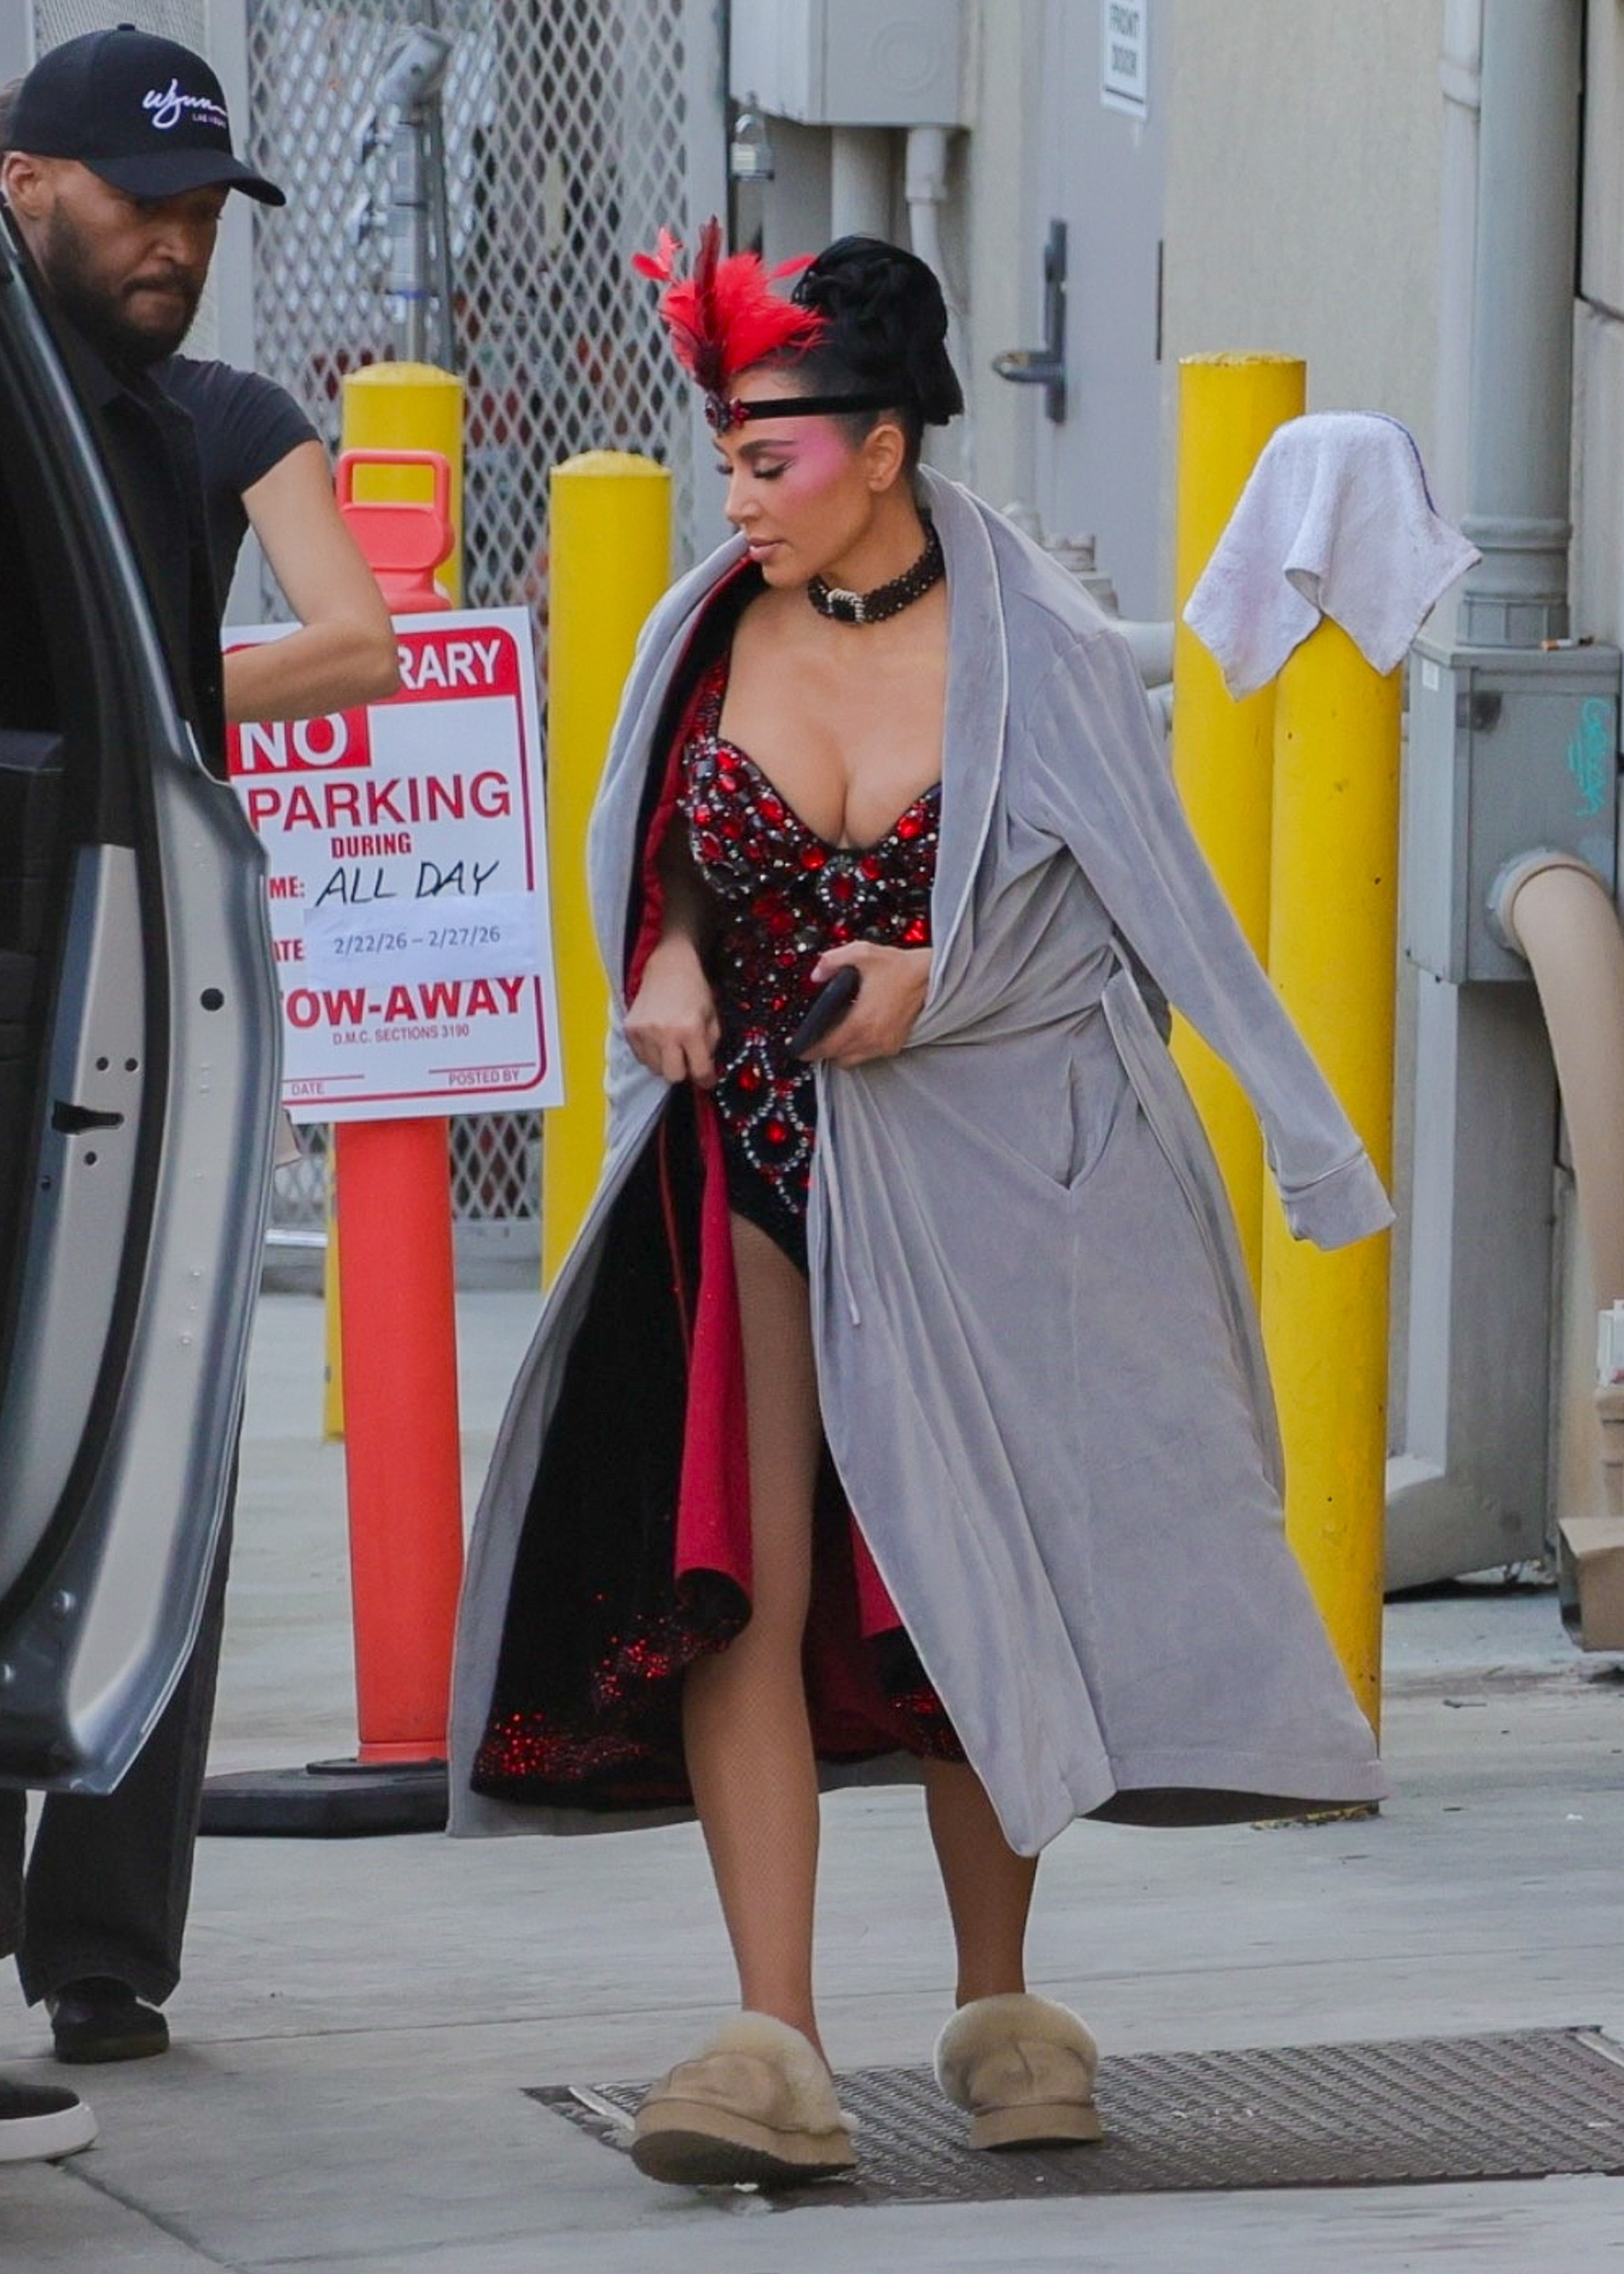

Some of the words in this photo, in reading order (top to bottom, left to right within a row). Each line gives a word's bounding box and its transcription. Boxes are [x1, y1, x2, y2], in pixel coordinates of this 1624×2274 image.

[239, 713, 349, 770] NO
[247, 772, 511, 833] PARKING
[331, 832, 411, 859] DURING
[315, 866, 398, 907] ALL
[416, 860, 499, 898] DAY
[334, 932, 407, 956] 2/22/26
[428, 926, 500, 949] 2/27/26
[279, 976, 524, 1028] OW-AWAY
[376, 1025, 438, 1042] SECTIONS
[291, 1082, 324, 1096] DATE
[448, 1070, 499, 1086] POSTED
[503, 1069, 521, 1082] BY
